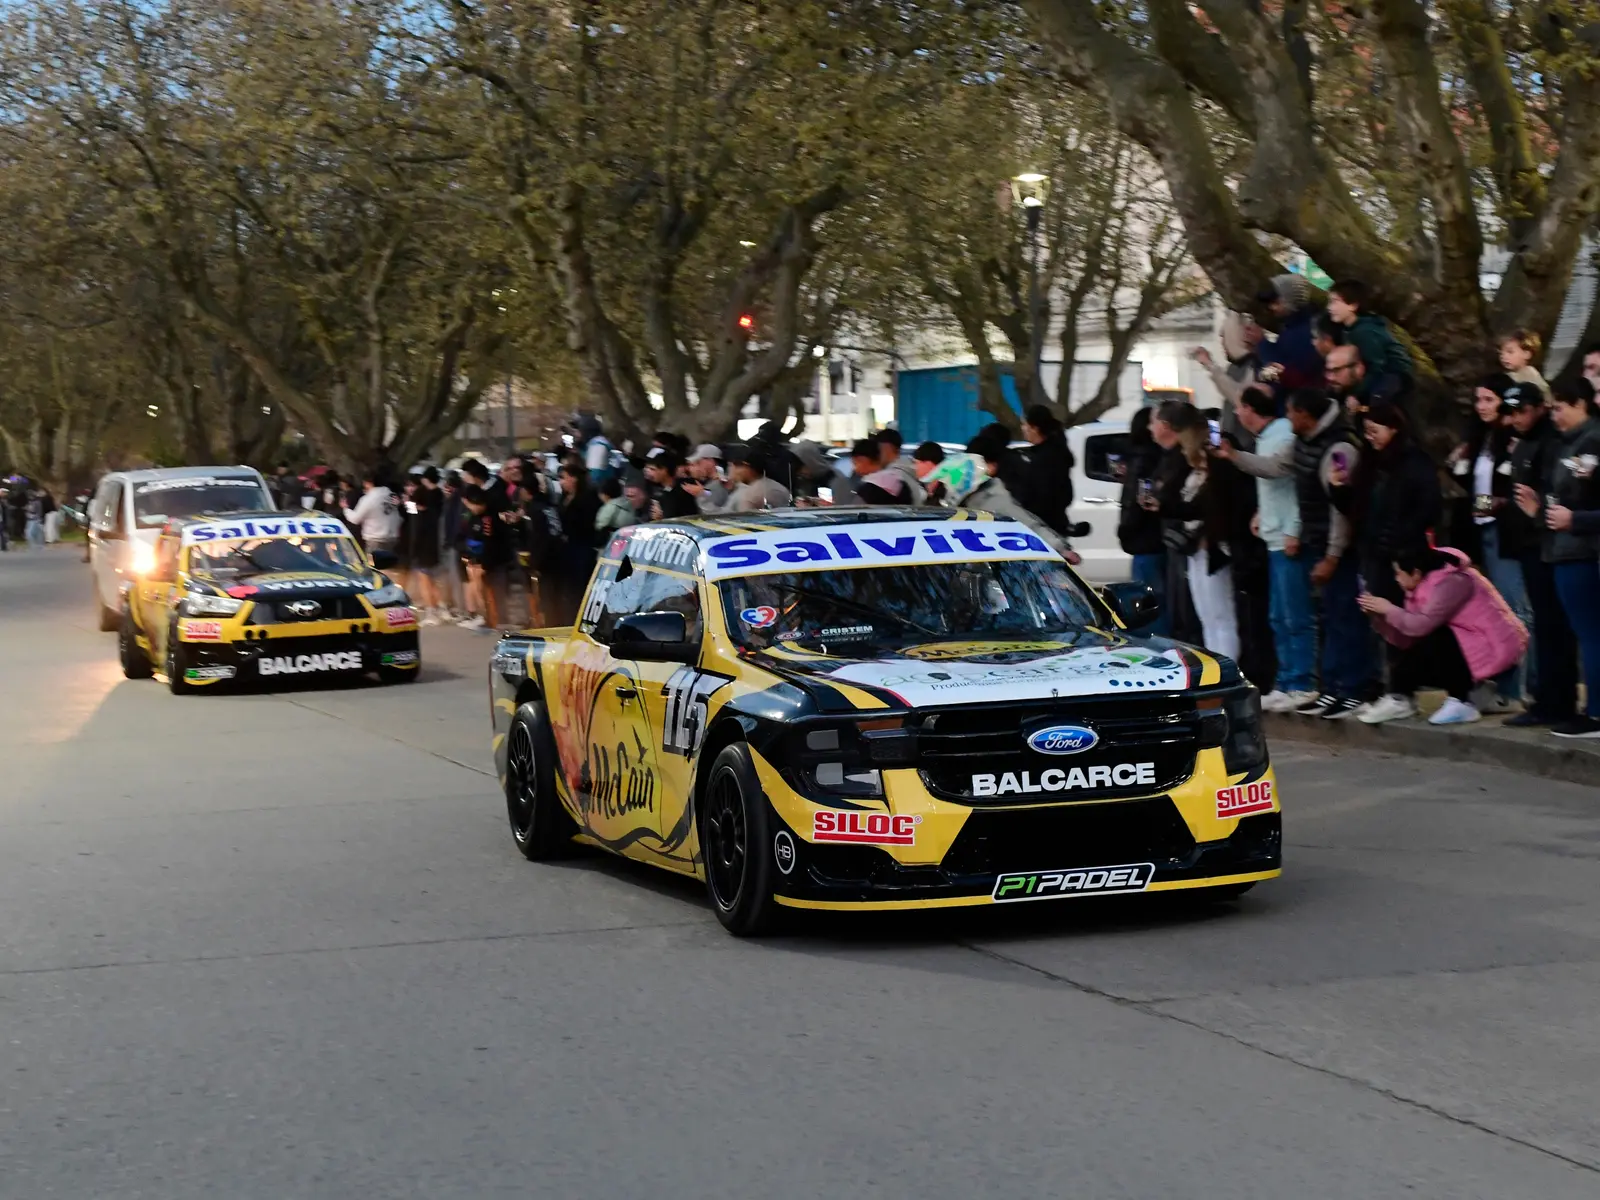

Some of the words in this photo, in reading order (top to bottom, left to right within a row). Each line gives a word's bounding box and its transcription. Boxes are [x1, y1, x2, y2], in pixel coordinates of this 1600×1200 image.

[192, 520, 343, 541] Salvita
[708, 528, 1050, 569] Salvita
[821, 625, 873, 635] CRISTEM
[258, 651, 363, 675] BALCARCE
[1044, 731, 1083, 750] Ford
[592, 741, 654, 820] McCain
[972, 763, 1156, 797] BALCARCE
[1217, 782, 1271, 808] SILOC
[814, 812, 914, 836] SILOC
